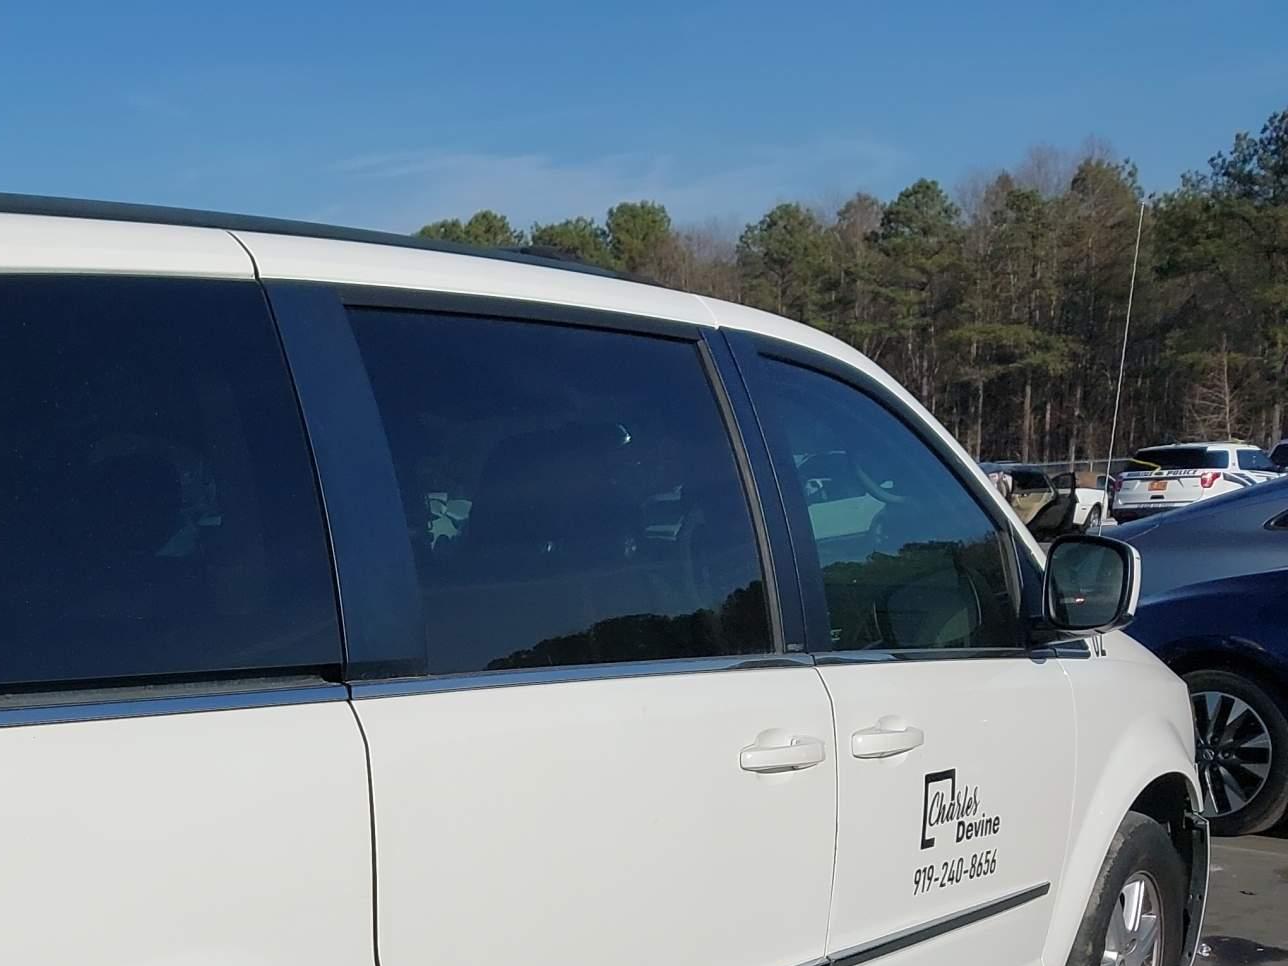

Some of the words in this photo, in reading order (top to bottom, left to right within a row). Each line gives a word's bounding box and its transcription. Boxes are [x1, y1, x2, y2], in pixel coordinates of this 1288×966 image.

[928, 785, 981, 827] Charles
[955, 812, 1000, 843] Devine
[913, 848, 998, 896] 919-240-8656
